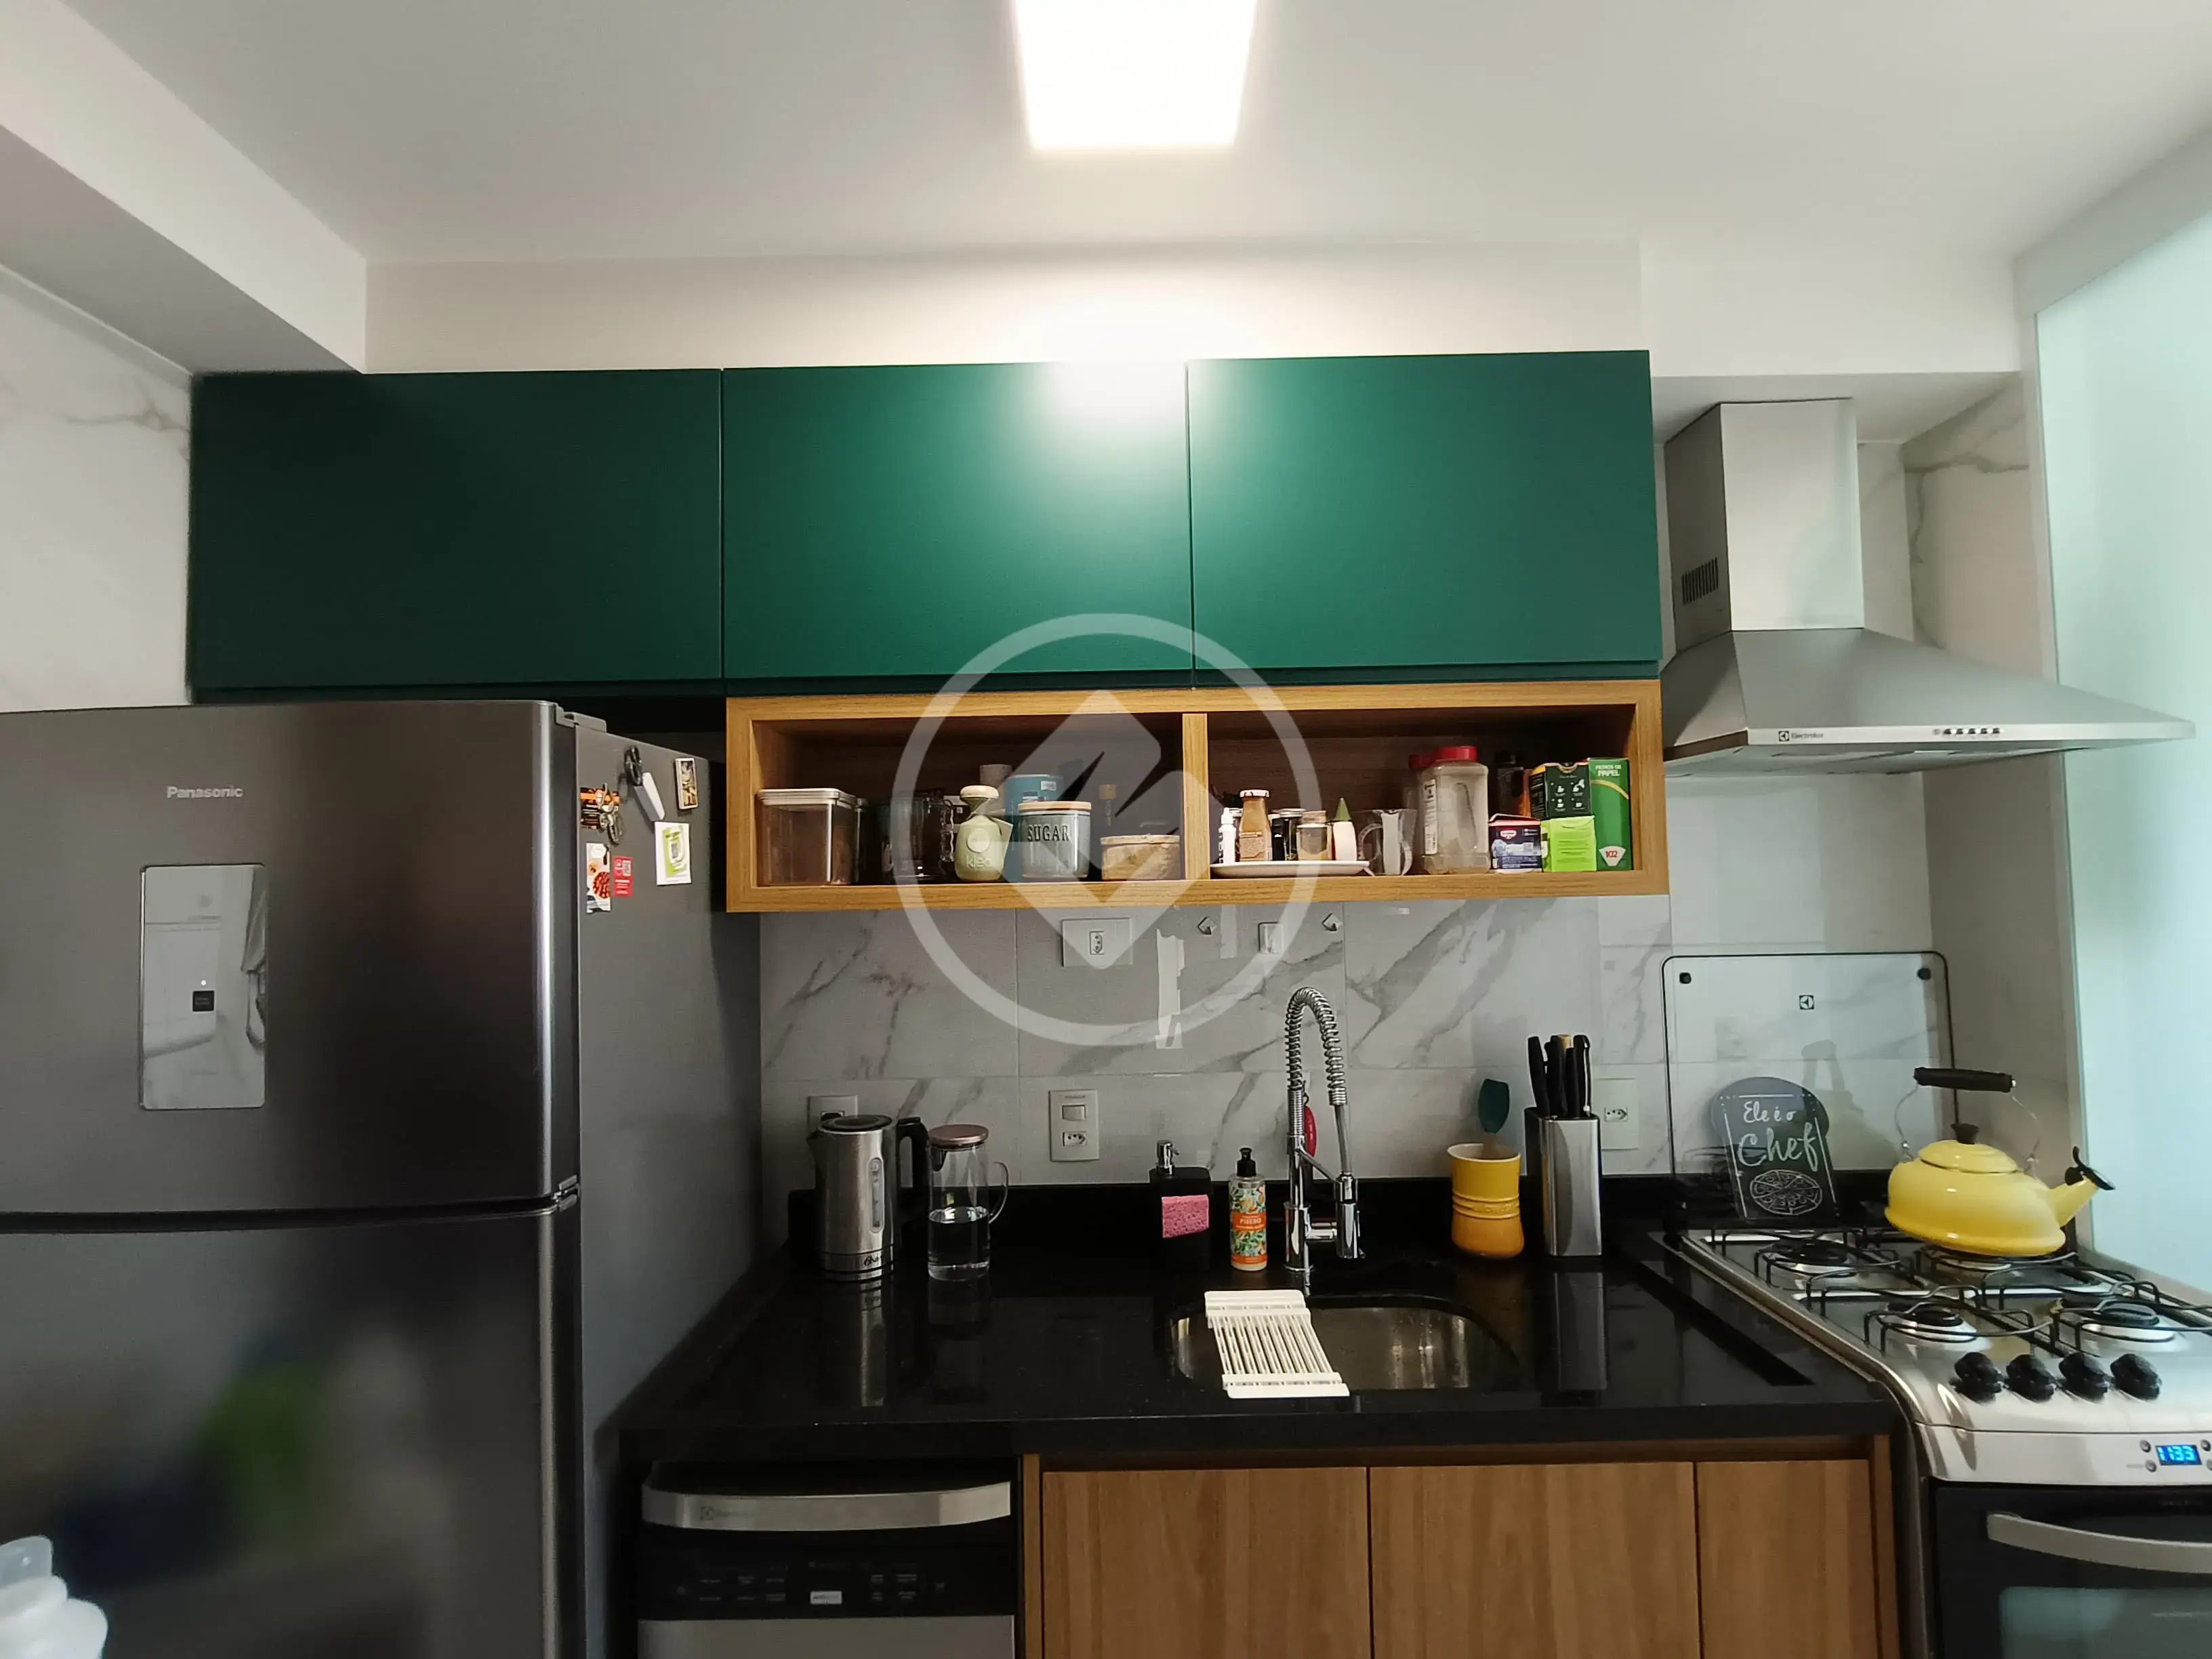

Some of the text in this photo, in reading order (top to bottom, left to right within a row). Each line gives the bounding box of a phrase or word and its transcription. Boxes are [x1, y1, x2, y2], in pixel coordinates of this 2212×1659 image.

[166, 785, 244, 799] Panasonic
[1027, 824, 1070, 842] SUGAR
[1743, 1101, 1797, 1124] Ele é o
[1737, 1122, 1818, 1172] Chef
